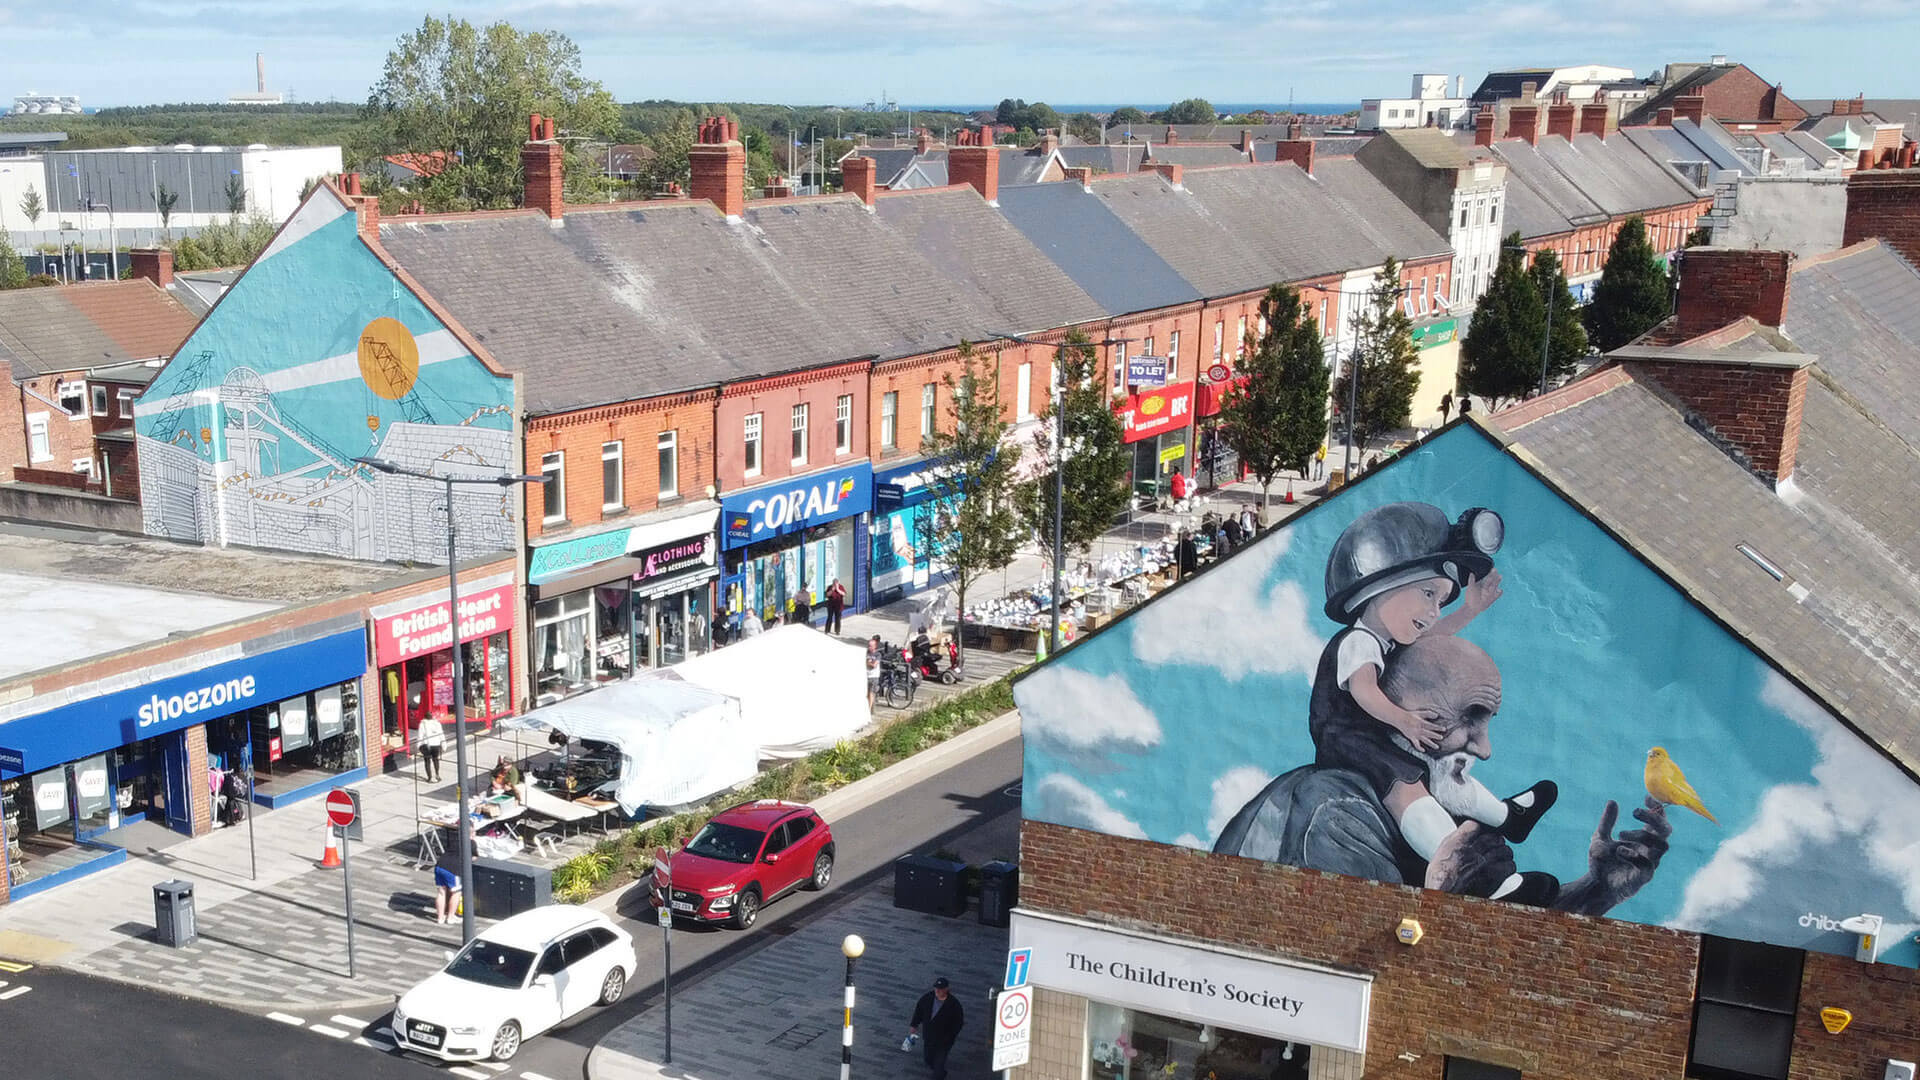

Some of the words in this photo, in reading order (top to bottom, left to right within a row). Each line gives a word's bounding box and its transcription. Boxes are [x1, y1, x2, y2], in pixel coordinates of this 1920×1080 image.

[1130, 366, 1144, 375] TO
[1146, 366, 1164, 375] LET
[746, 481, 839, 534] CORAL
[728, 530, 750, 538] CORAL
[652, 541, 702, 565] CLOTHING
[392, 606, 450, 638] British
[400, 616, 497, 656] Foundtion
[138, 675, 256, 727] shoezone
[1066, 952, 1103, 975] The
[1109, 962, 1217, 997] Children's
[1223, 983, 1304, 1018] Society
[1004, 1002, 1025, 1020] 20
[999, 1029, 1026, 1043] ZONE
